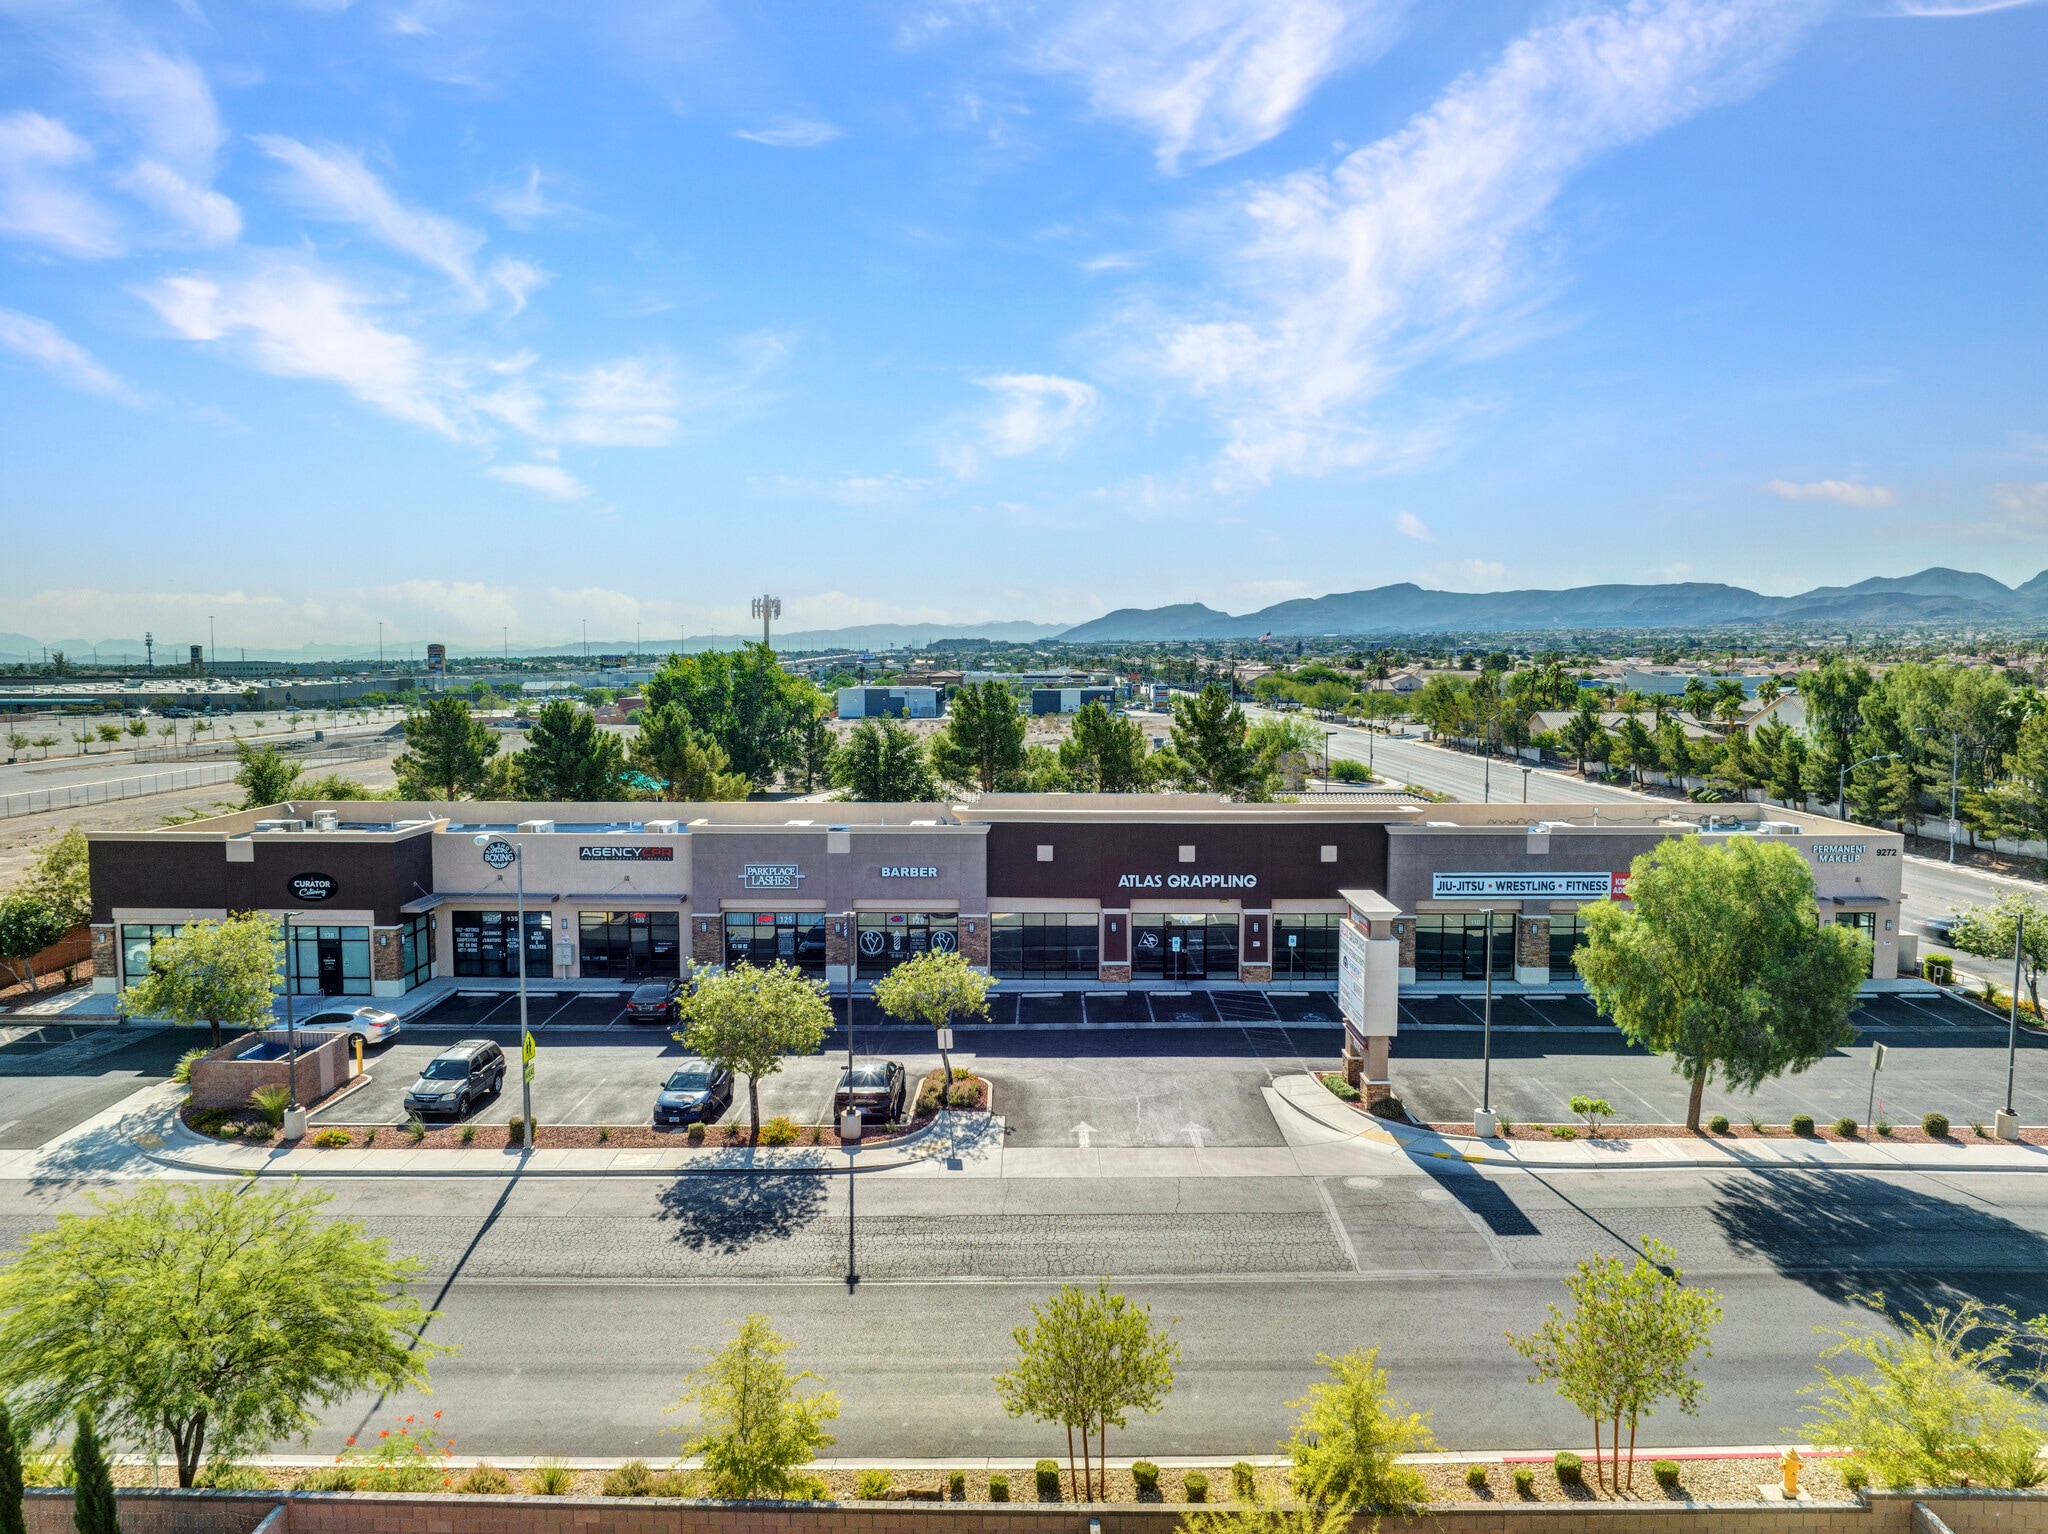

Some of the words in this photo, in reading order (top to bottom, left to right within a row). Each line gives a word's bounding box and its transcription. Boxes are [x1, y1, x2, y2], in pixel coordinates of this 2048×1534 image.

[1812, 845, 1867, 853] PERMANENT
[1876, 848, 1897, 857] 9272
[484, 853, 514, 862] BOXING
[1818, 854, 1860, 863] MAKEUP
[747, 867, 769, 876] PARK
[769, 867, 796, 876] PLACE
[881, 867, 938, 877] BARBER
[294, 880, 331, 888] CURATOR
[751, 875, 791, 886] LASHES
[1118, 874, 1163, 888] ATLAS
[1167, 874, 1257, 888] GRAPPLING
[1437, 881, 1485, 891] JIU-JITSU
[1495, 881, 1556, 891] WRESTLING
[1566, 881, 1608, 891] FITNESS
